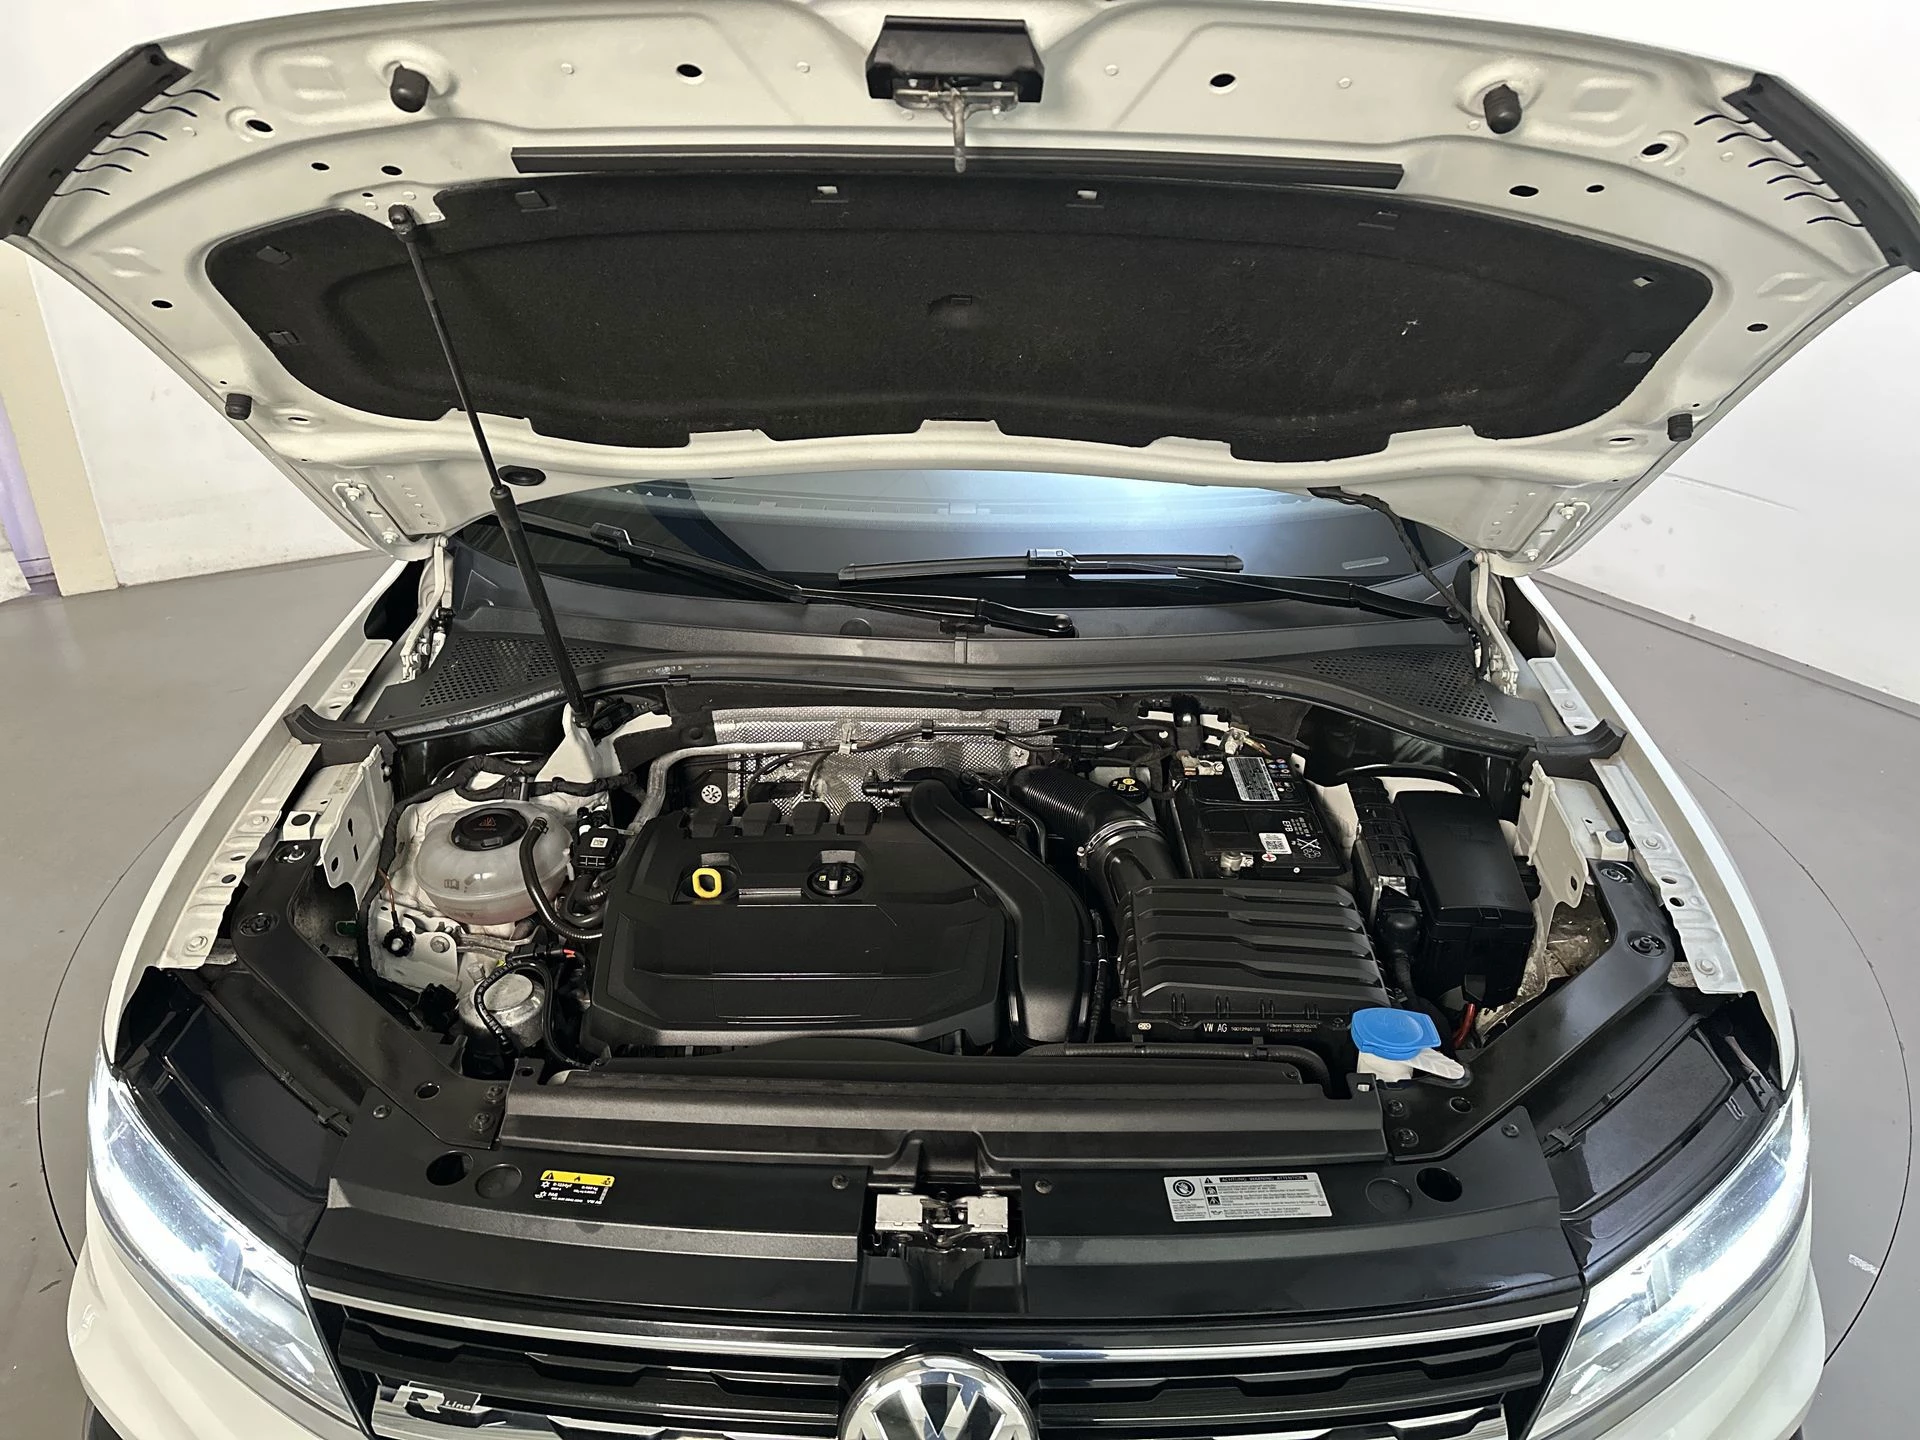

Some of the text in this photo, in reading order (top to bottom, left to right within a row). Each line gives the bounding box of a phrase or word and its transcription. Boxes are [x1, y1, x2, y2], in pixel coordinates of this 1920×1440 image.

[1282, 820, 1293, 832] EFB
[1203, 1023, 1214, 1032] VW
[1217, 1023, 1228, 1033] AG
[392, 1384, 472, 1414] R Line
